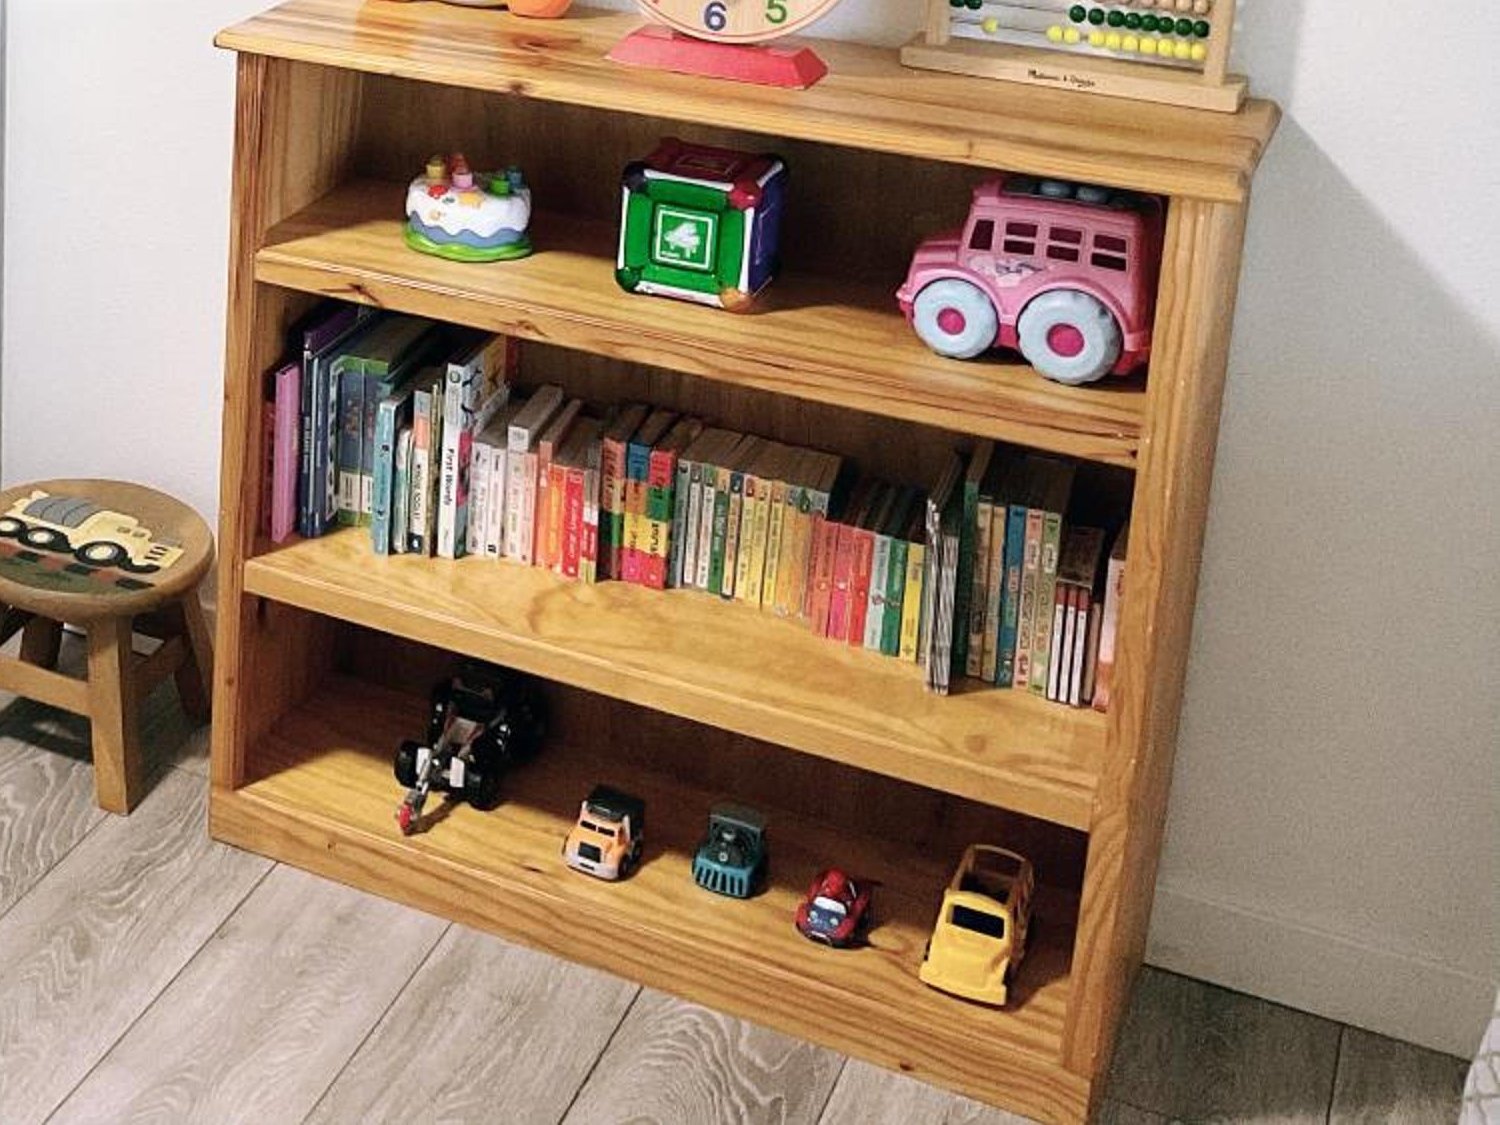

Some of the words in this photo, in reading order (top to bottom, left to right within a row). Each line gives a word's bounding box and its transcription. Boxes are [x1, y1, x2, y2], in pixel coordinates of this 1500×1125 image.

[704, 1, 727, 31] 6
[445, 448, 455, 470] First
[443, 474, 453, 506] Words
